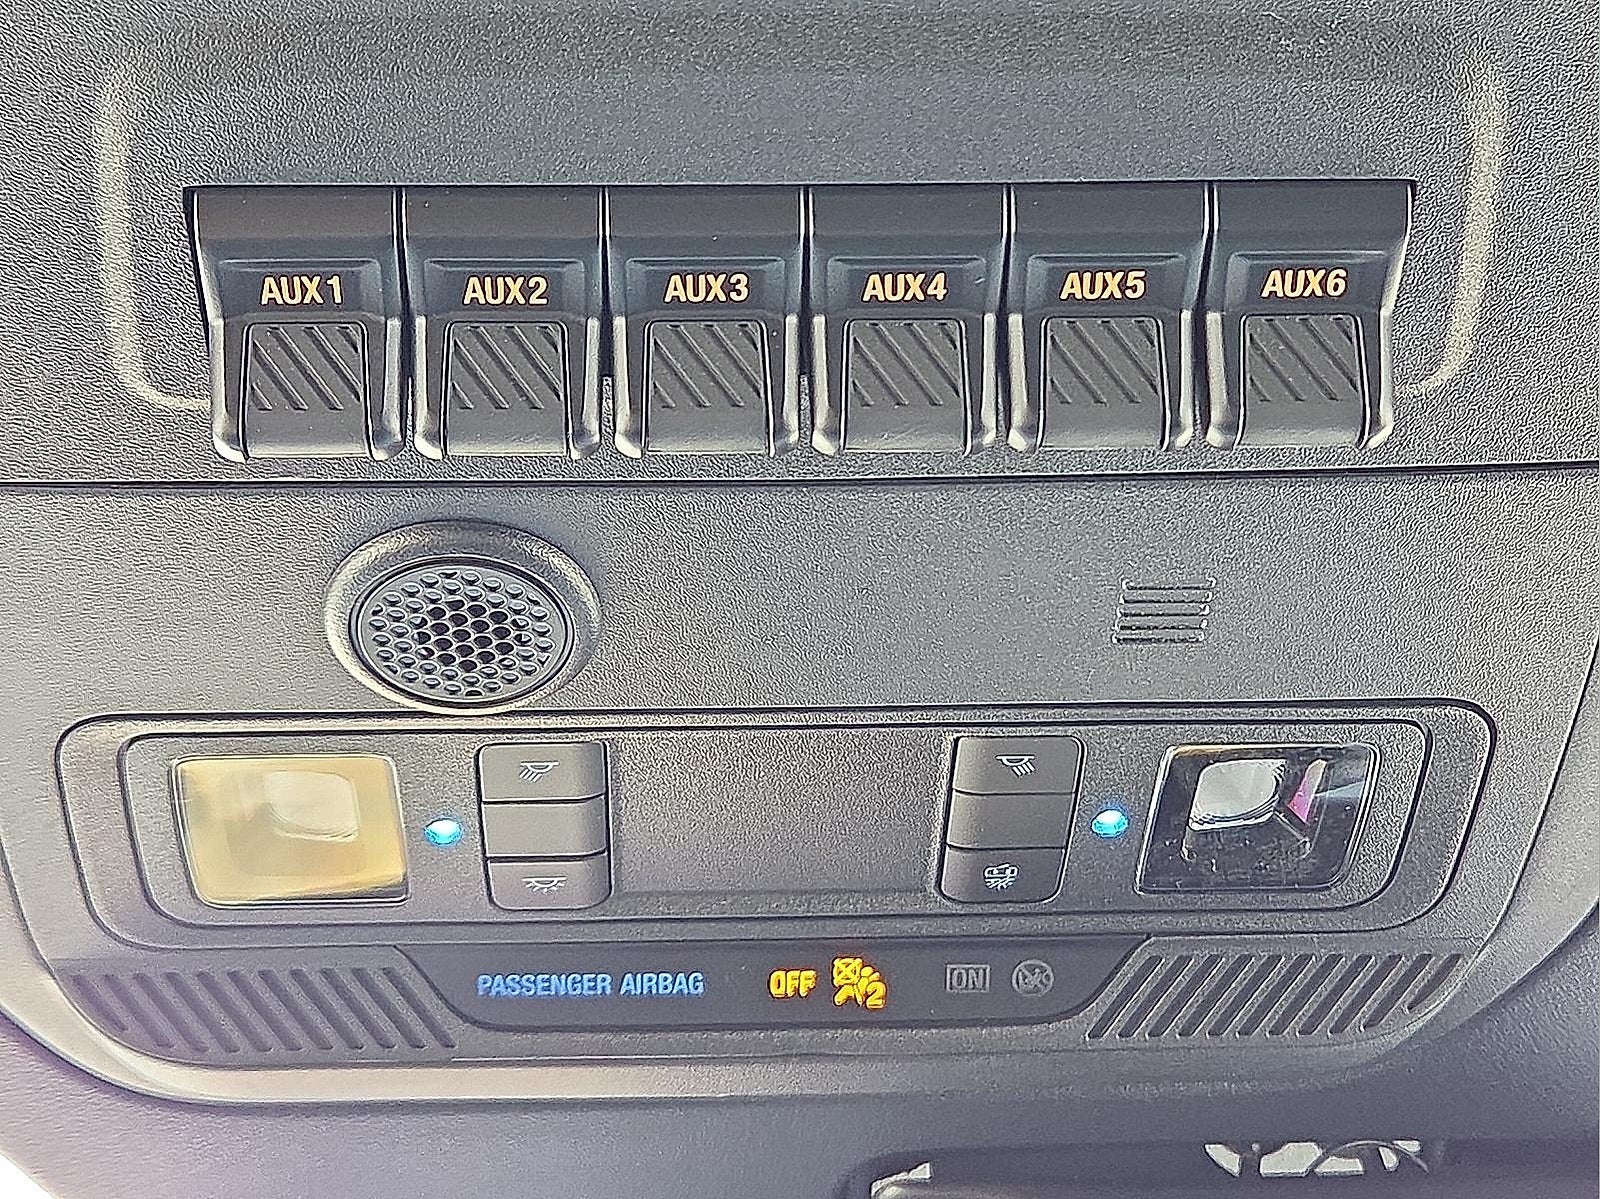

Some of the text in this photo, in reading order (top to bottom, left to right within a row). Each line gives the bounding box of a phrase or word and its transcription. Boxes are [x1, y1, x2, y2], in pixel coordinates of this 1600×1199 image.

[261, 275, 343, 305] AUX1
[463, 275, 549, 306] AUX2
[663, 272, 750, 303] AUX3
[862, 271, 948, 302] AUX4
[1059, 269, 1147, 300] AUX5
[1261, 268, 1348, 299] AUX6
[477, 970, 704, 998] PASSENGER AIRBAG
[768, 969, 817, 998] OFF
[951, 967, 985, 989] ON
[865, 980, 887, 1010] 2
